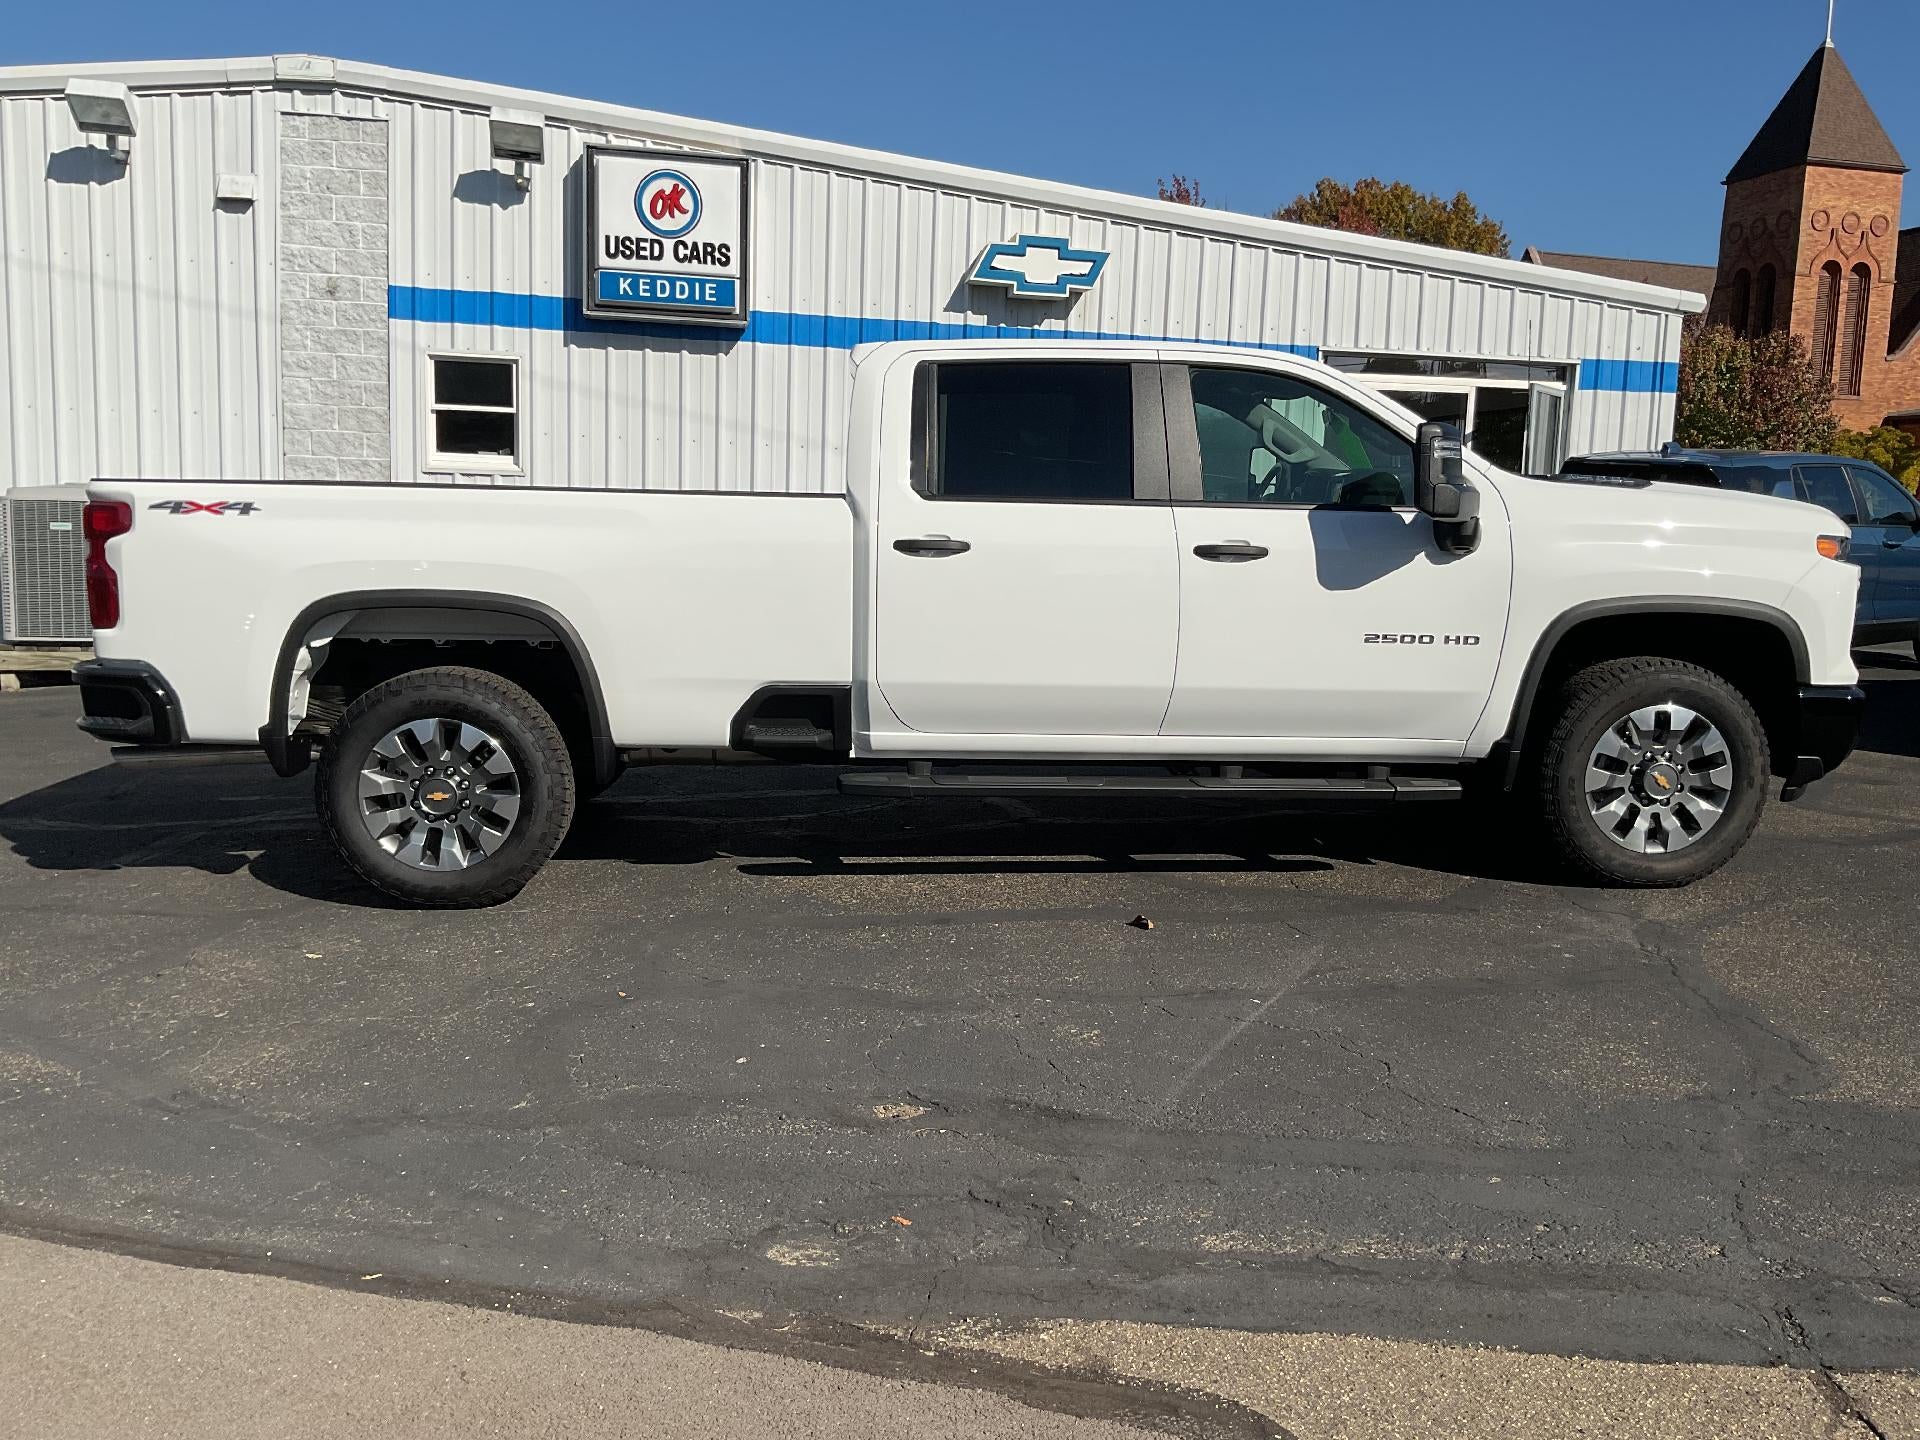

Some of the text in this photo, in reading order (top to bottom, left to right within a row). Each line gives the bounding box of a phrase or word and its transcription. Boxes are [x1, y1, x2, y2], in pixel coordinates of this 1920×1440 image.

[650, 183, 689, 220] OK
[605, 235, 731, 267] USED CARS
[619, 277, 717, 302] KEDDIE
[1363, 633, 1480, 646] 2500 HD
